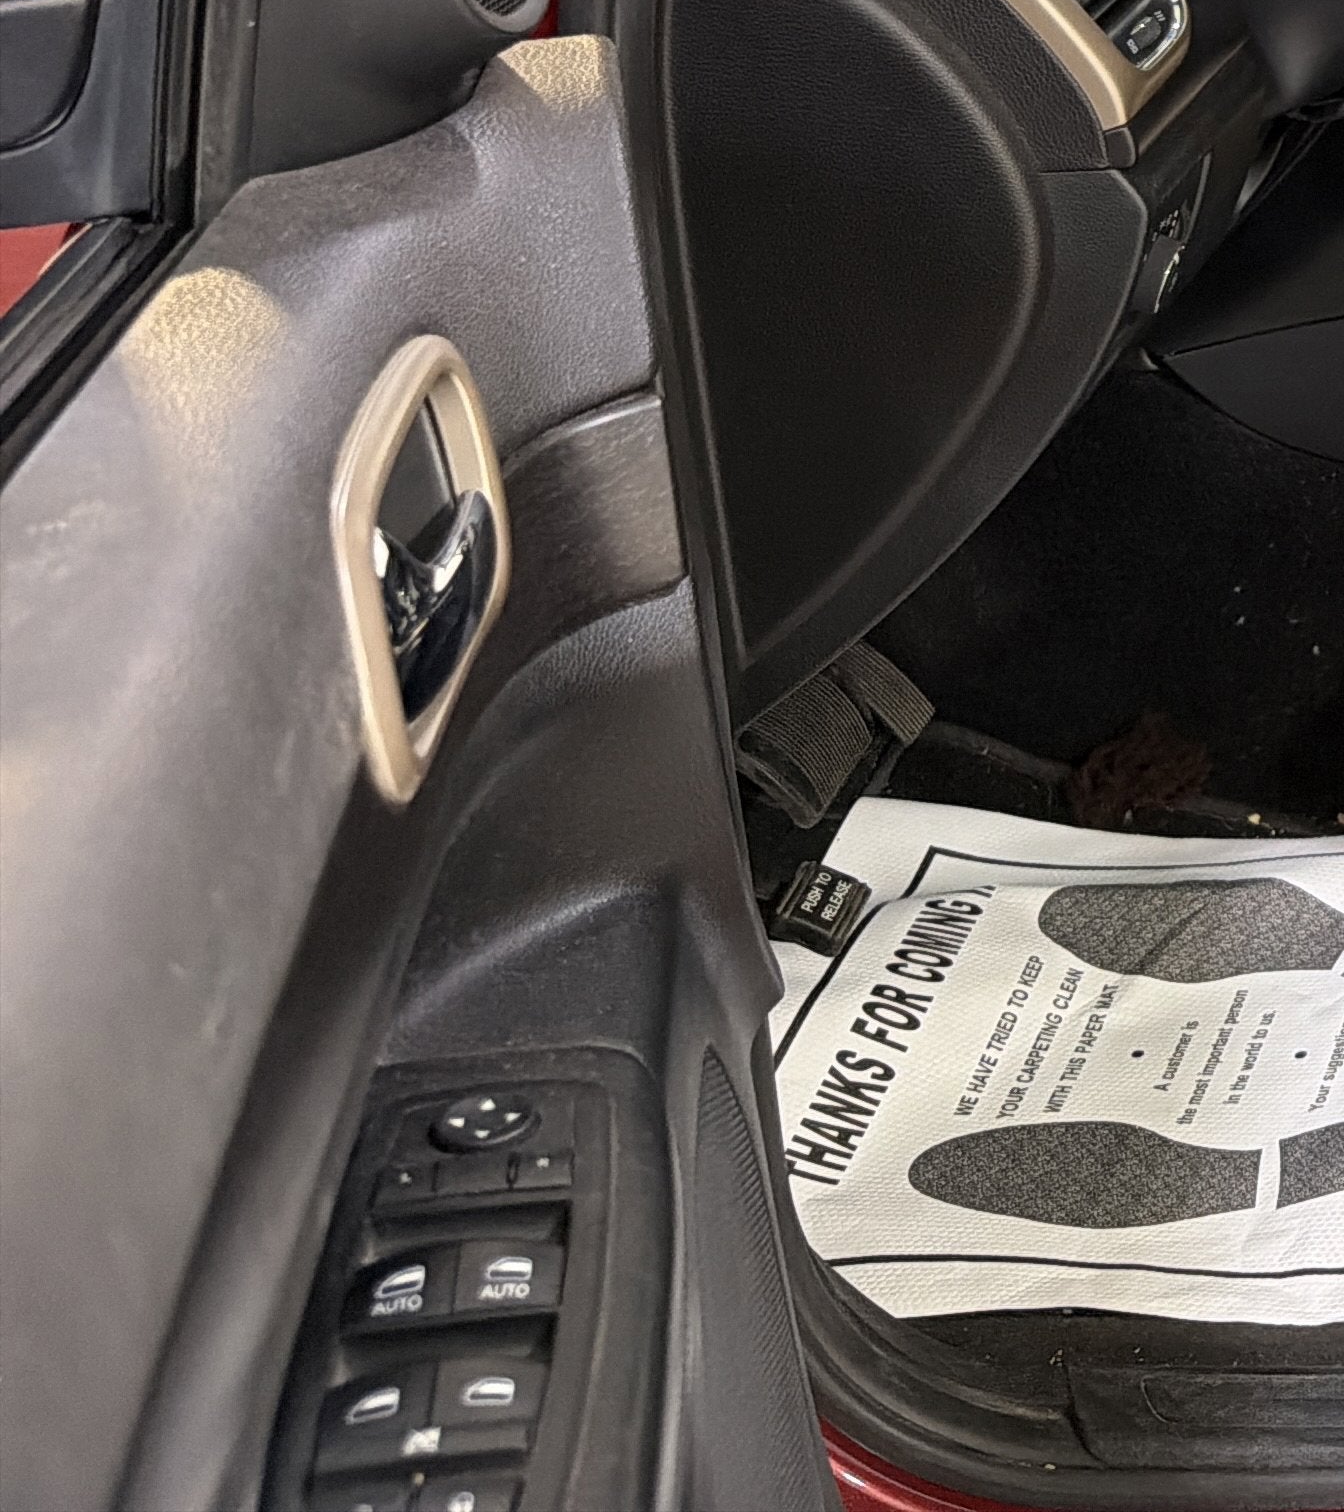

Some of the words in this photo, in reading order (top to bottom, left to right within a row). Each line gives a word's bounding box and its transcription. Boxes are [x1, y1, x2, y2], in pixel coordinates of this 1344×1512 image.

[801, 887, 825, 913] PUSH
[815, 872, 832, 886] TO
[820, 879, 852, 922] RELEASE
[885, 899, 984, 983] COMING
[1017, 955, 1045, 988] KEEP
[1007, 988, 1029, 1008] TO
[1224, 989, 1249, 1025] person
[849, 983, 934, 1053] FOR
[986, 1011, 1018, 1051] TRIED
[1251, 1028, 1269, 1039] to
[1260, 1010, 1277, 1026] us.
[996, 1086, 1029, 1119] YOUR
[1016, 1012, 1063, 1084] CARPETING
[1052, 967, 1084, 1010] CLEAN
[1043, 1085, 1073, 1113] WITH
[1060, 1057, 1087, 1081] THIS
[1074, 1013, 1107, 1054] PAPER
[1094, 983, 1120, 1009] MAT
[1153, 1082, 1171, 1092] A
[1162, 1033, 1194, 1080] customer
[1181, 1020, 1200, 1030] is
[1197, 1027, 1234, 1076] important
[1240, 1042, 1263, 1072] world
[966, 1053, 999, 1093] HAVE
[1229, 1074, 1250, 1091] the
[953, 1095, 979, 1116] WE
[1189, 1078, 1211, 1105] most
[1222, 1093, 1242, 1105] in
[1308, 1084, 1331, 1113] Your
[784, 1049, 896, 1186] THANKS
[1176, 1108, 1197, 1125] the
[370, 1294, 423, 1317] AUTO
[479, 1283, 530, 1301] AUTO
